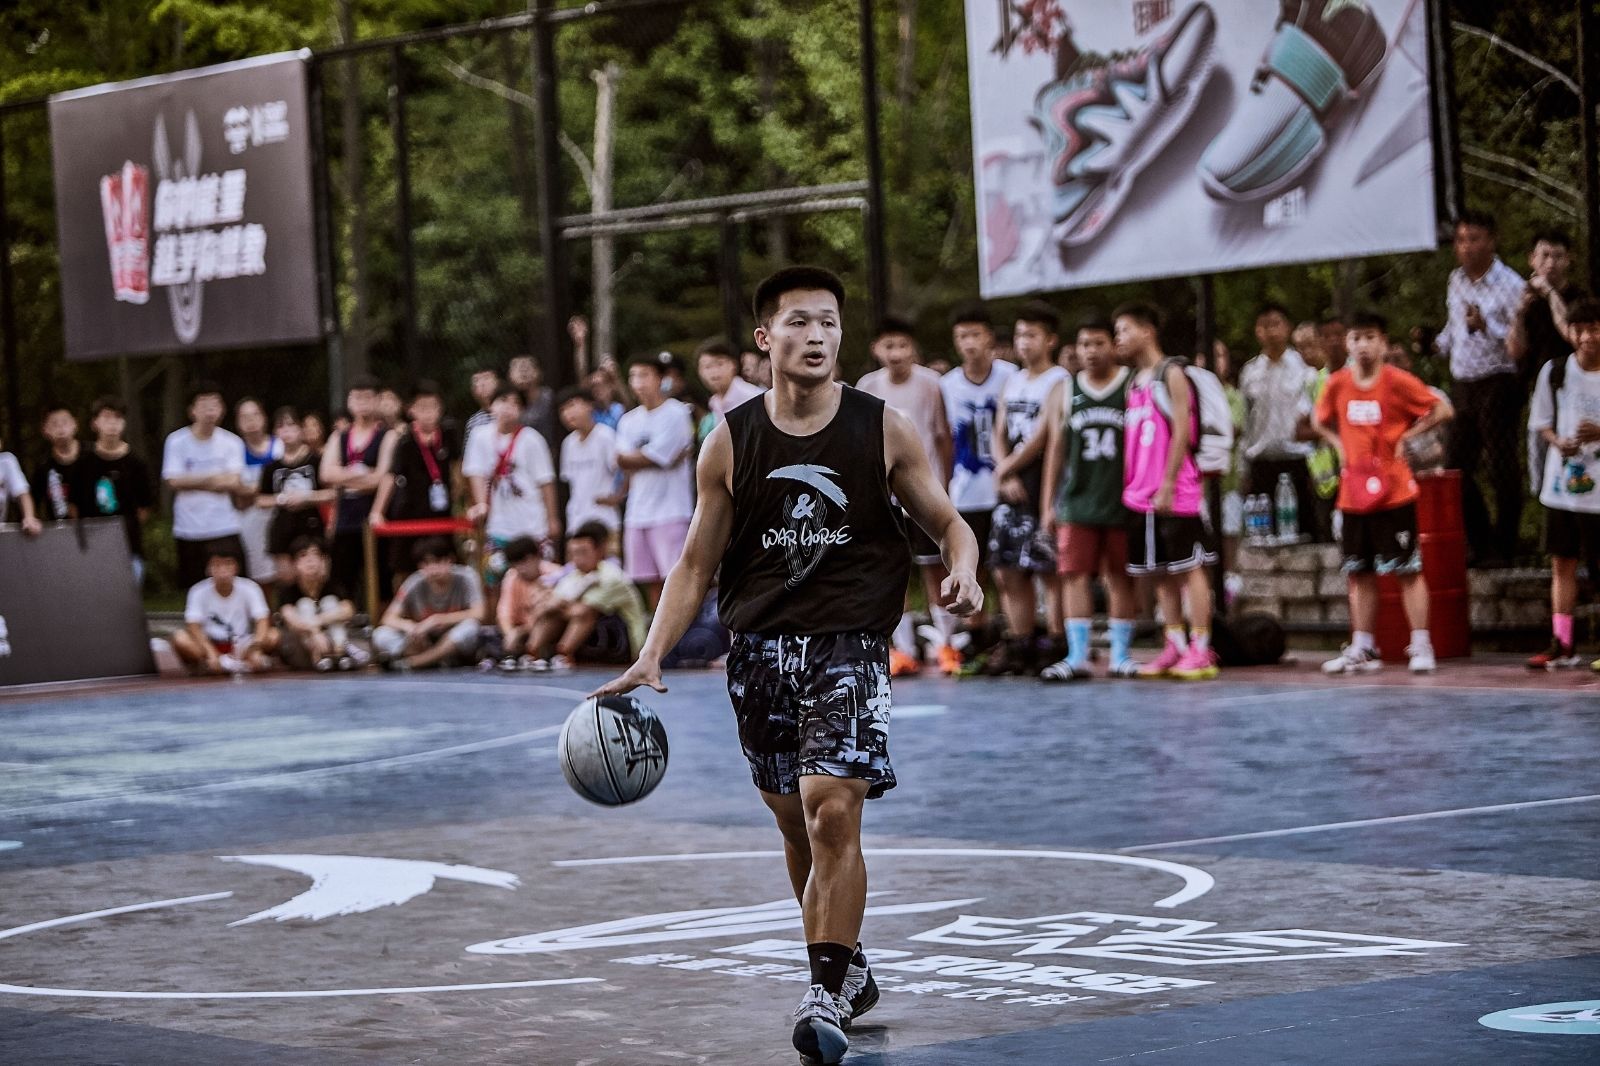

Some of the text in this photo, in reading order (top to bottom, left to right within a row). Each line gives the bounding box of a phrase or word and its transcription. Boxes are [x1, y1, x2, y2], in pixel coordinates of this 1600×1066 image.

[1081, 427, 1117, 461] 34
[762, 521, 853, 549] WAR HORSE
[869, 955, 1217, 995] HORSE
